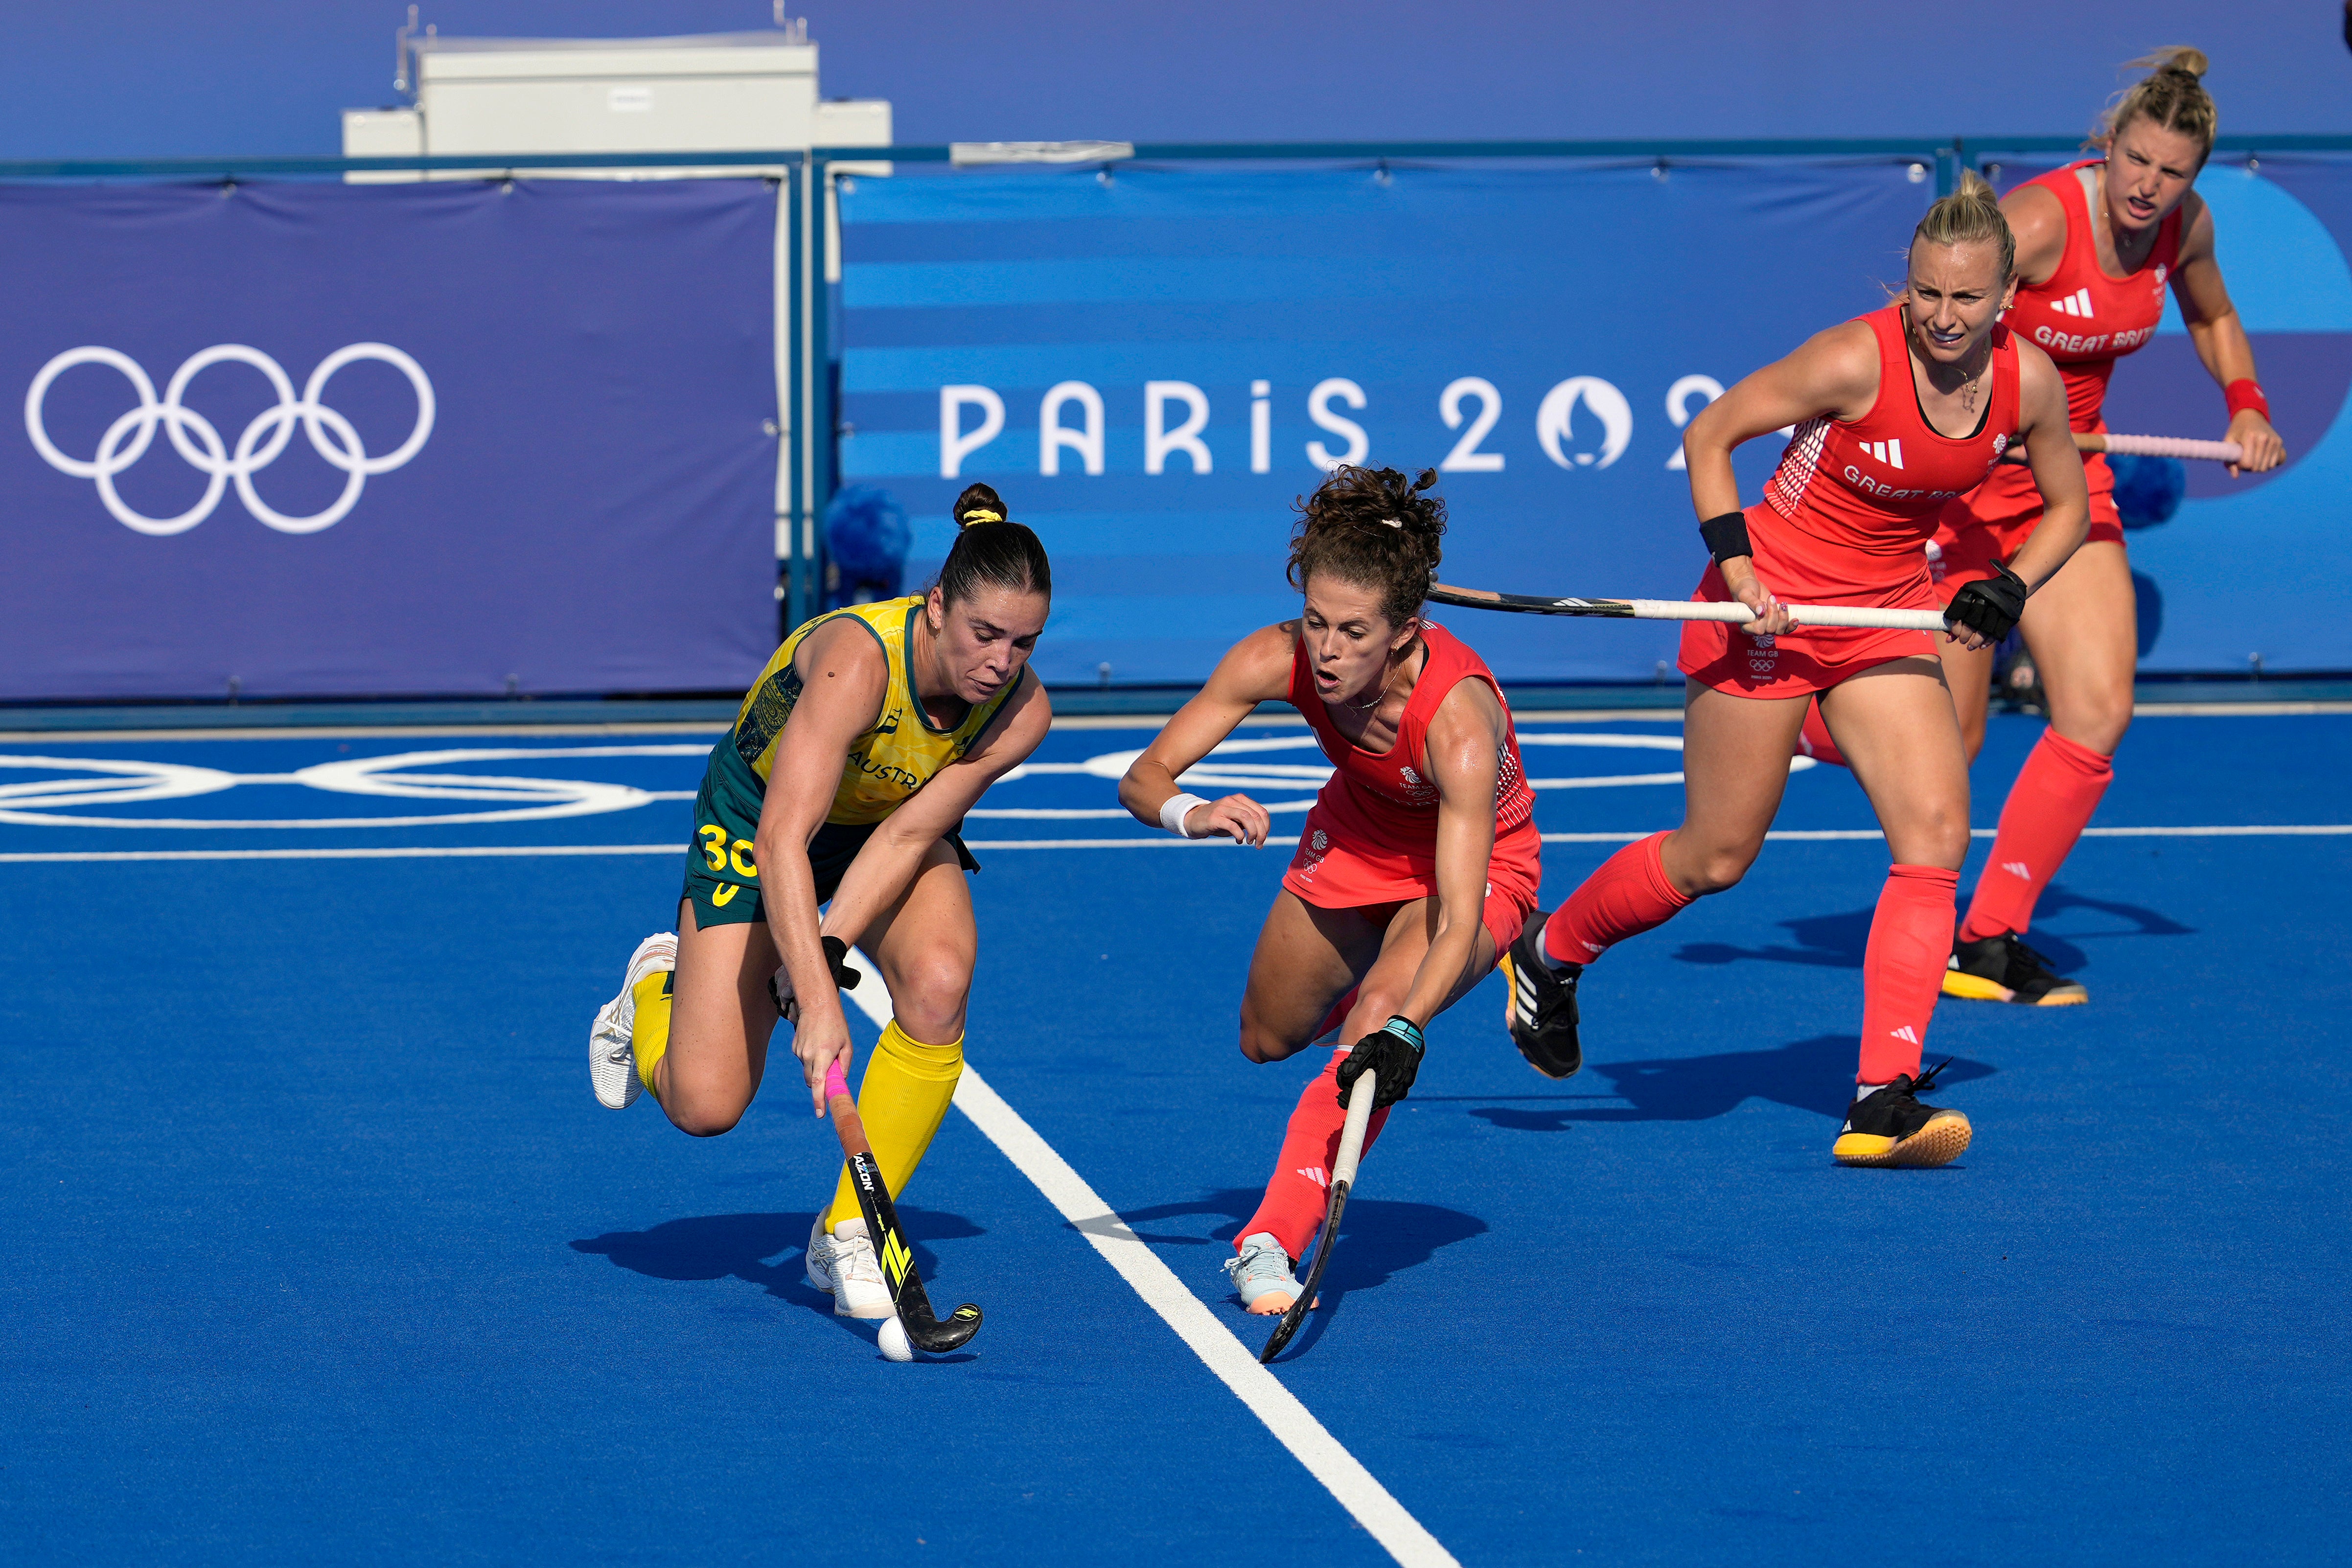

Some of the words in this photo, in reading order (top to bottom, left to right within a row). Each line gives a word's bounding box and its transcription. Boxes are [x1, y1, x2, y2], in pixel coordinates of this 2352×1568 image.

[2034, 325, 2109, 353] GREAT
[1844, 465, 1924, 500] GREAT
[848, 750, 927, 790] AUSTR
[698, 824, 758, 877] 30
[1305, 847, 1315, 859] TEAM
[1315, 855, 1324, 863] GB
[853, 1153, 874, 1191] AZON
